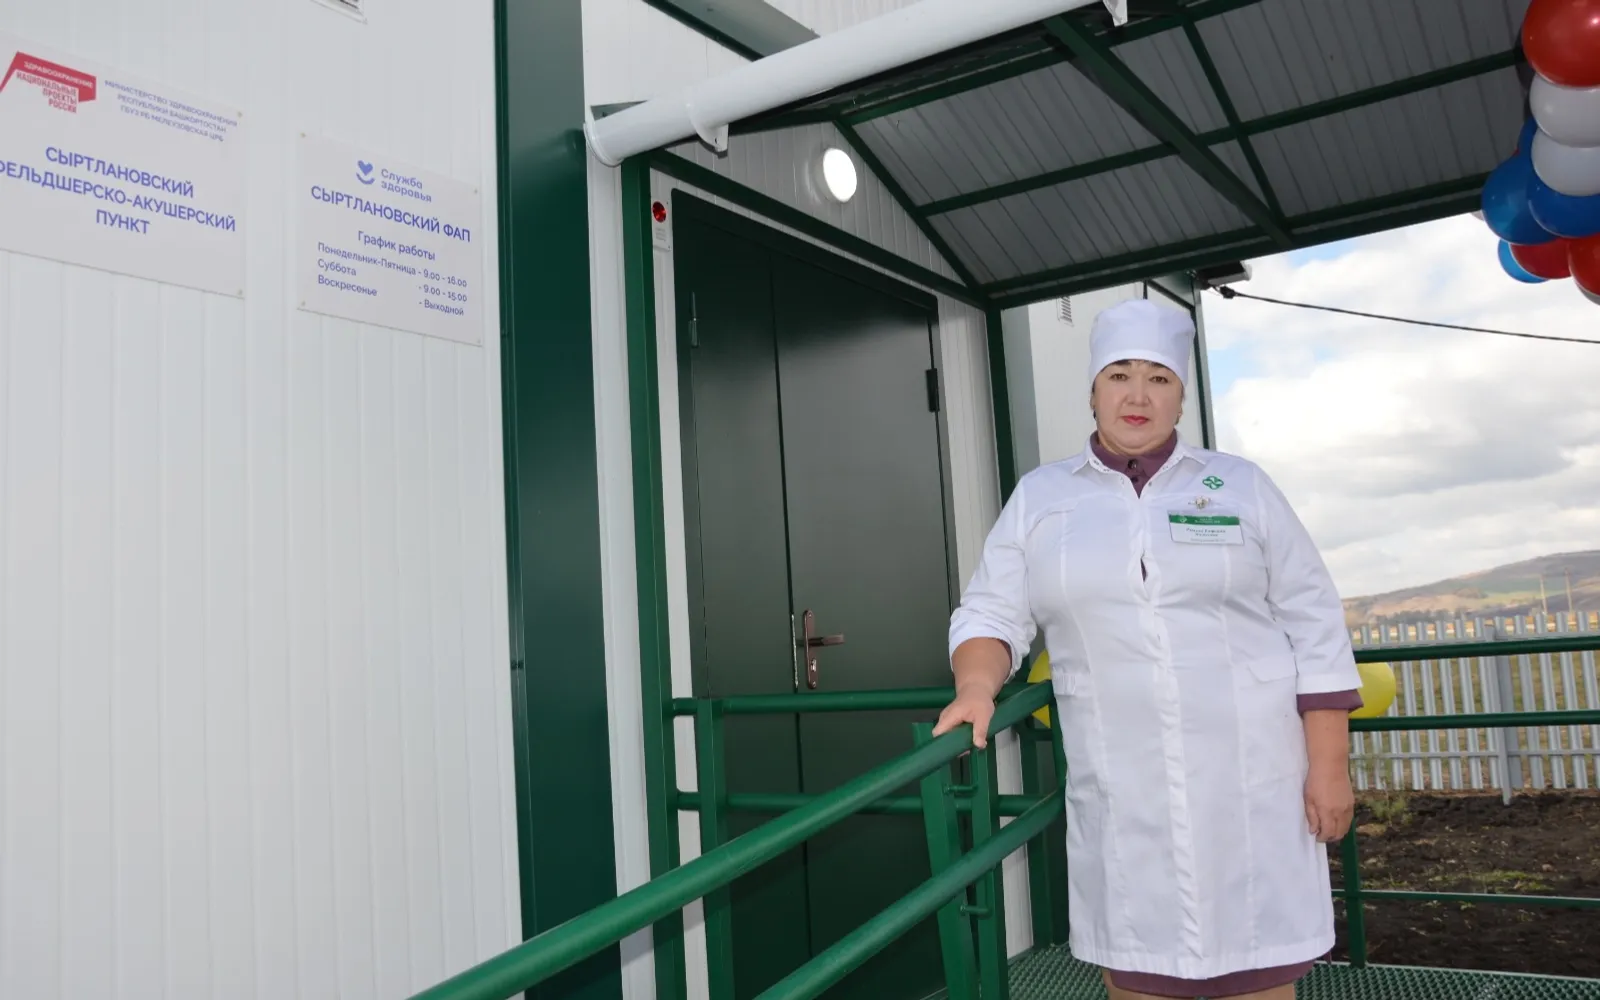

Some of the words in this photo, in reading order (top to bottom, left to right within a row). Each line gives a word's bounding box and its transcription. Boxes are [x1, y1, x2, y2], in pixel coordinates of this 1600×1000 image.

[16, 71, 77, 97] НАЦИОНАЛЬНЫЕ
[42, 87, 77, 105] ПРОЕКТЫ
[104, 80, 168, 105] МИНИСТЕРСТВО
[48, 98, 77, 114] РОССИИ
[117, 93, 169, 115] РЕСПУБЛИКИ
[170, 109, 226, 133] БАШКОРТОСТАН
[120, 104, 139, 117] ГБУЗ
[45, 146, 194, 199] СЫРТЛАНОВСКИЙ
[380, 168, 423, 190] Служба
[380, 181, 432, 203] здоровья
[95, 208, 150, 235] ПУНКТ
[311, 185, 440, 235] СЫРТЛАНОВСКИЙ
[443, 223, 471, 243] ФАП
[358, 230, 397, 250] График
[398, 243, 436, 261] работы
[318, 242, 417, 275] Понедельник-Пятница
[423, 268, 441, 281] 9.00
[317, 258, 357, 276] Суббота
[423, 284, 441, 296] 9.00
[447, 291, 468, 302] 15.00
[318, 274, 378, 297] Воскресенье
[424, 299, 465, 316] Выходной
